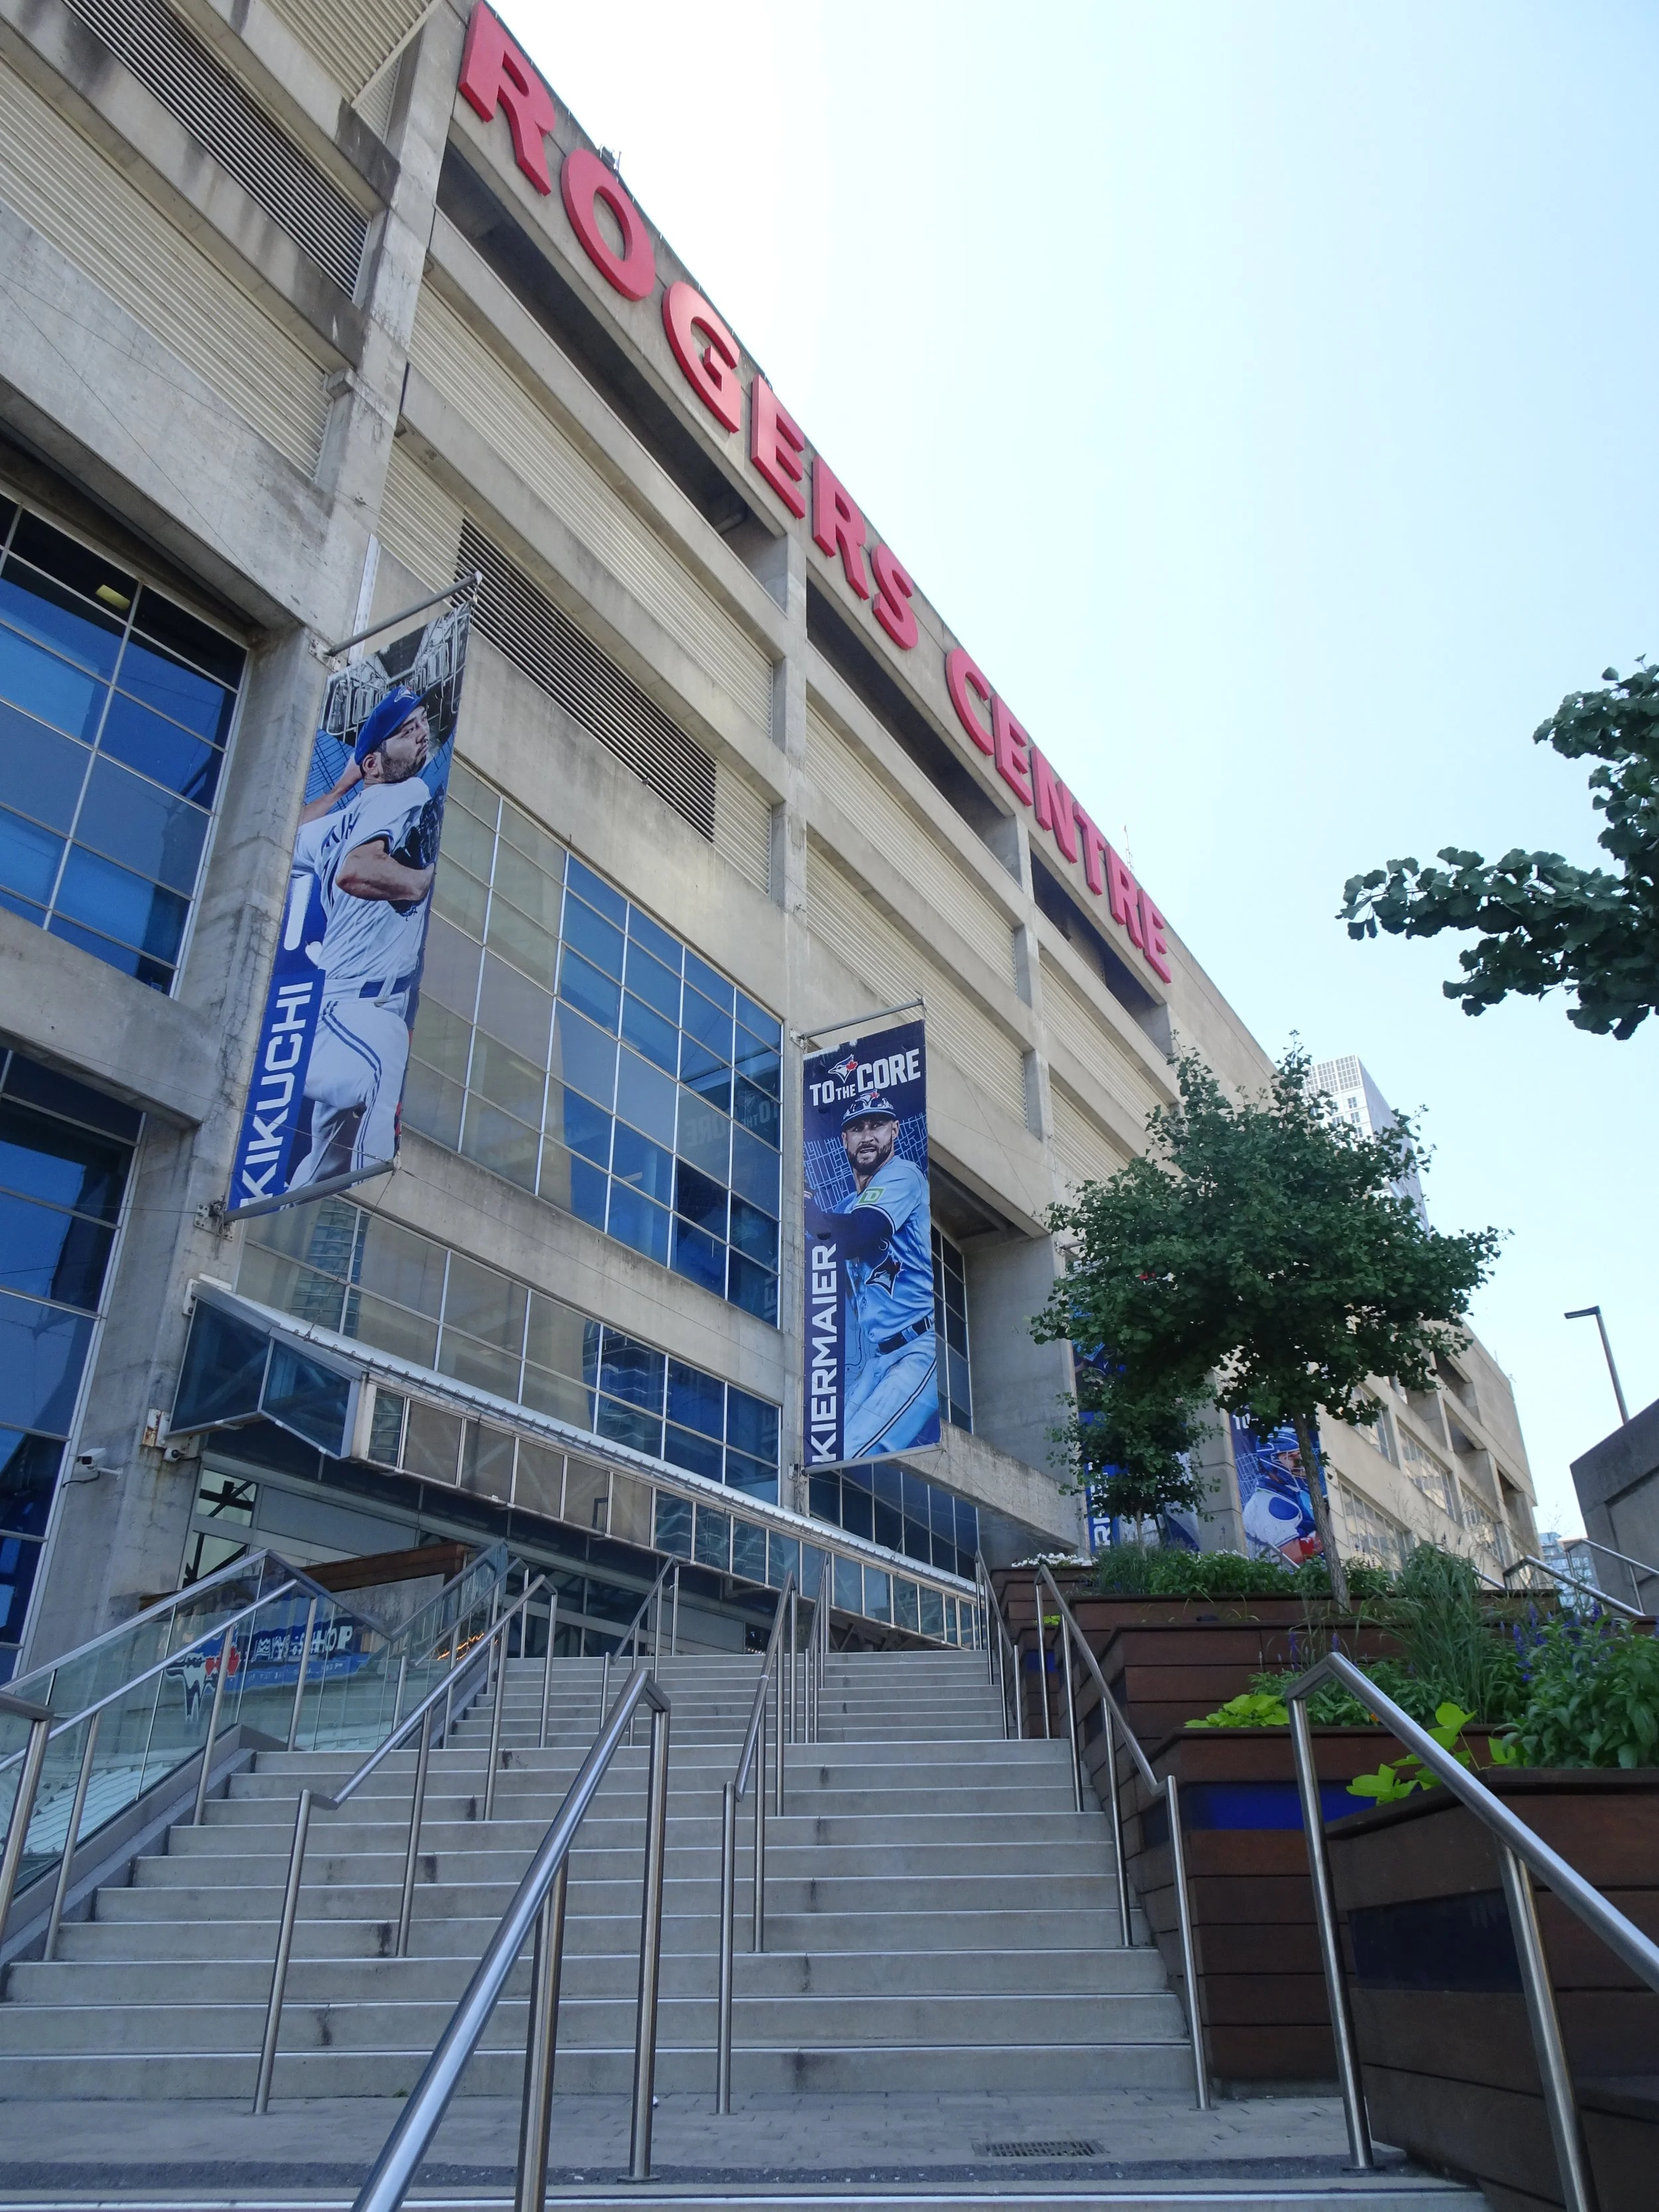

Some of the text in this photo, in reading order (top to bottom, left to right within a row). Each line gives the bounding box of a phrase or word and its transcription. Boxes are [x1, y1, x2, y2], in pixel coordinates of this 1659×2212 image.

[459, 1, 1173, 984] ROGERS CENTRE
[238, 982, 313, 1209] KIKUCHI
[809, 1048, 921, 1106] TO THE CORE
[811, 1243, 837, 1462] KIERMAIER
